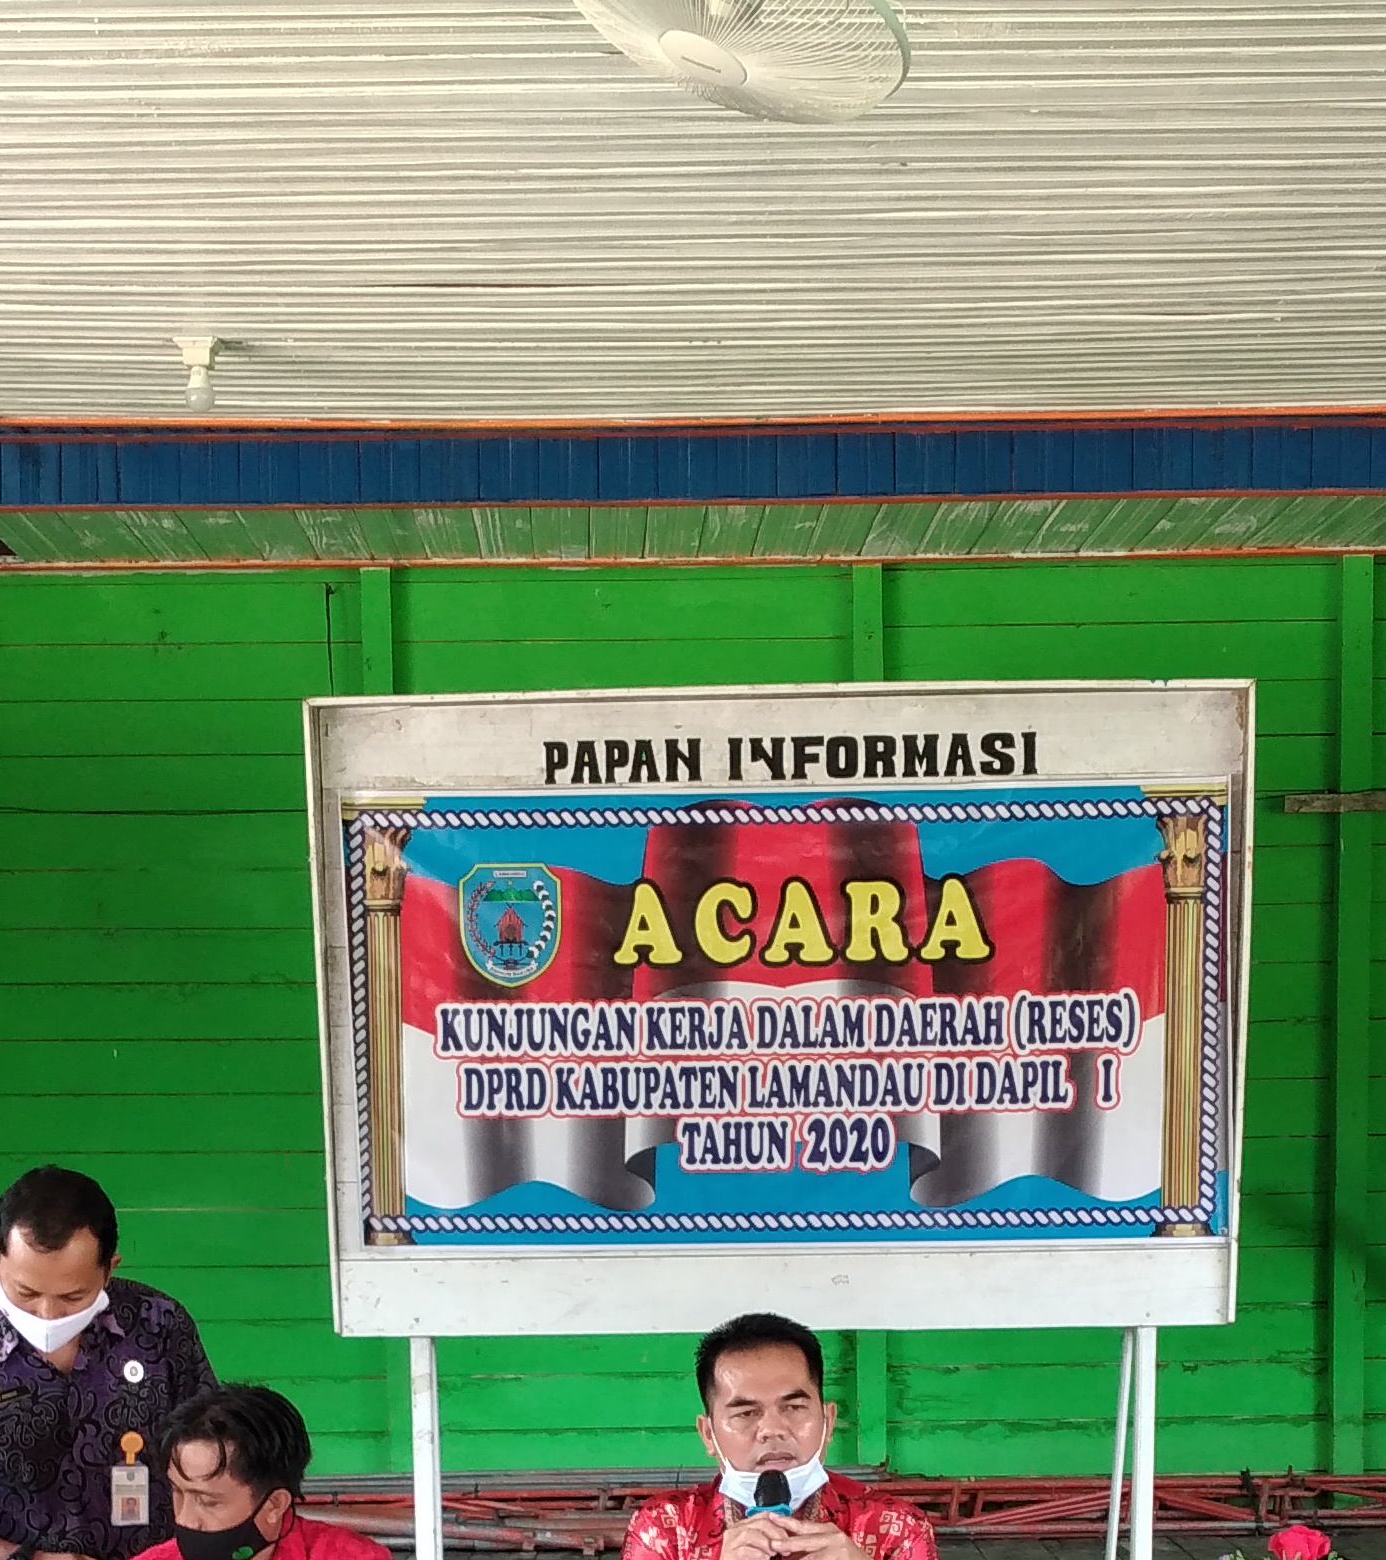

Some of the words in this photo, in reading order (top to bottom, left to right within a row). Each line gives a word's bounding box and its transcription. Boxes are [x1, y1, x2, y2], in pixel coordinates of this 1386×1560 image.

[542, 737, 703, 785] PAPAN
[727, 731, 1038, 781] INFORMASI
[611, 875, 993, 966] ACARA
[439, 1005, 637, 1052] KUNJUNGAN
[645, 1004, 749, 1051] KERJA
[756, 1003, 866, 1050] DALAM
[873, 1000, 1005, 1047] DAERAH
[1014, 992, 1136, 1050] (RESES)
[463, 1065, 547, 1112] DPRD
[555, 1063, 738, 1111] KABUPATEN
[748, 1060, 925, 1109] LAMANDAU
[932, 1061, 971, 1104] DI
[975, 1059, 1069, 1104] DAPIL
[682, 1120, 789, 1166] TAHUN
[806, 1115, 891, 1167] 2020
